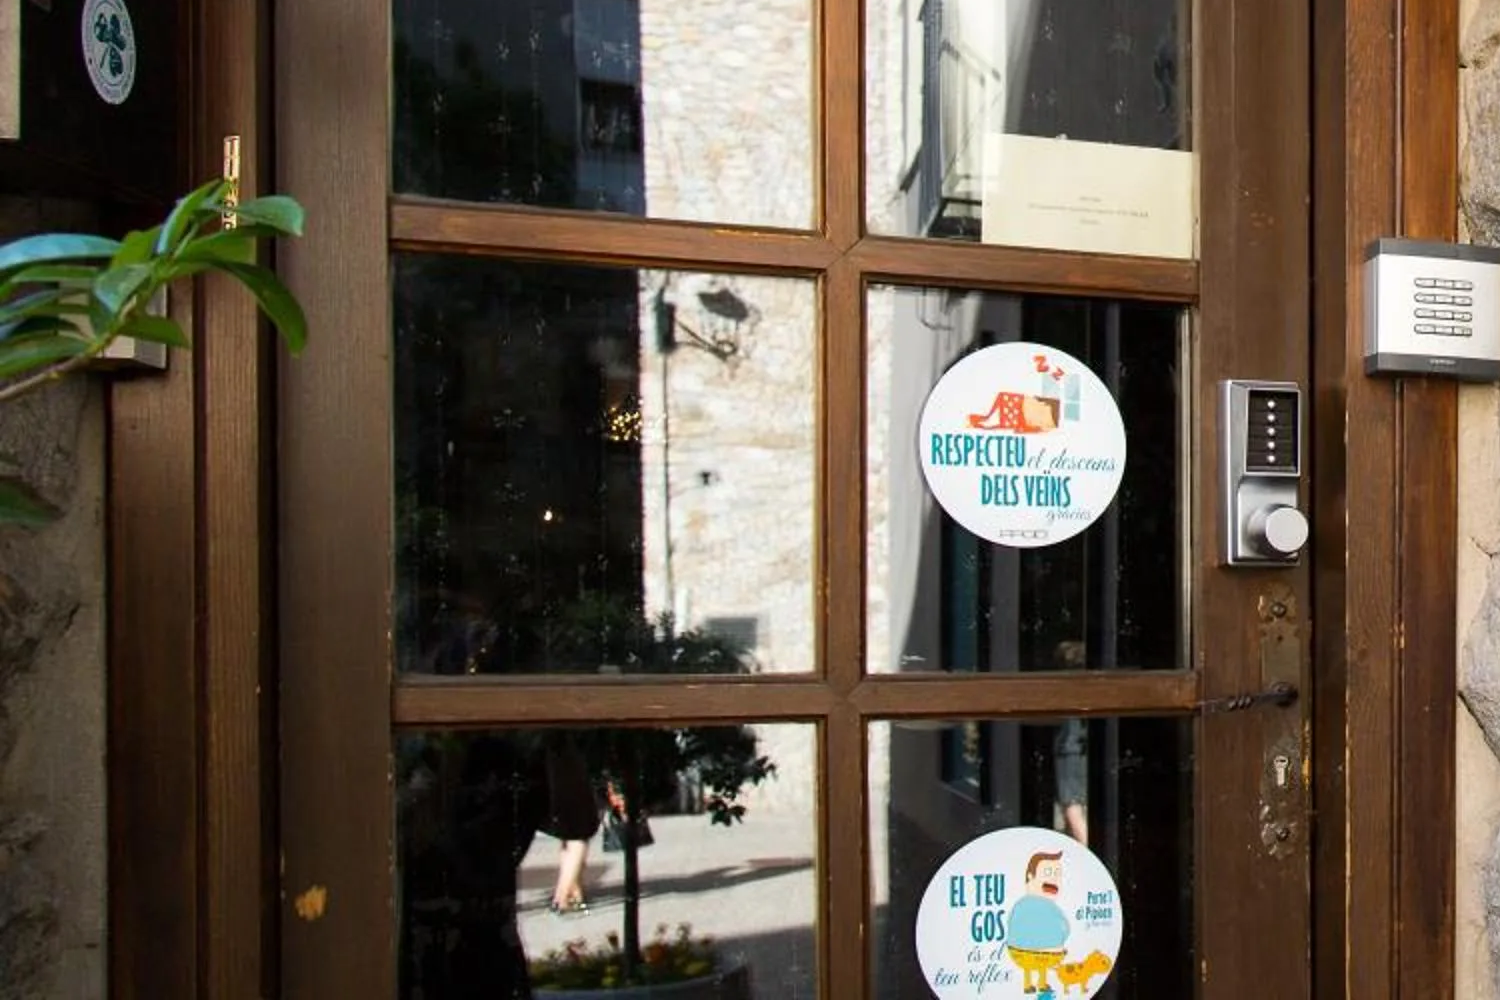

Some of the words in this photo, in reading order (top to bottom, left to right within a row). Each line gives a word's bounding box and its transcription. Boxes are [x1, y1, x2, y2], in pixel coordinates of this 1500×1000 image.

[931, 433, 1026, 468] RESPECTEU
[1027, 447, 1047, 469] el
[1049, 447, 1117, 472] descans
[981, 473, 1020, 507] DELS
[1024, 469, 1072, 509] VEÏNS
[951, 875, 967, 908] EL
[973, 873, 1006, 906] TEU
[971, 909, 1006, 943] GOS
